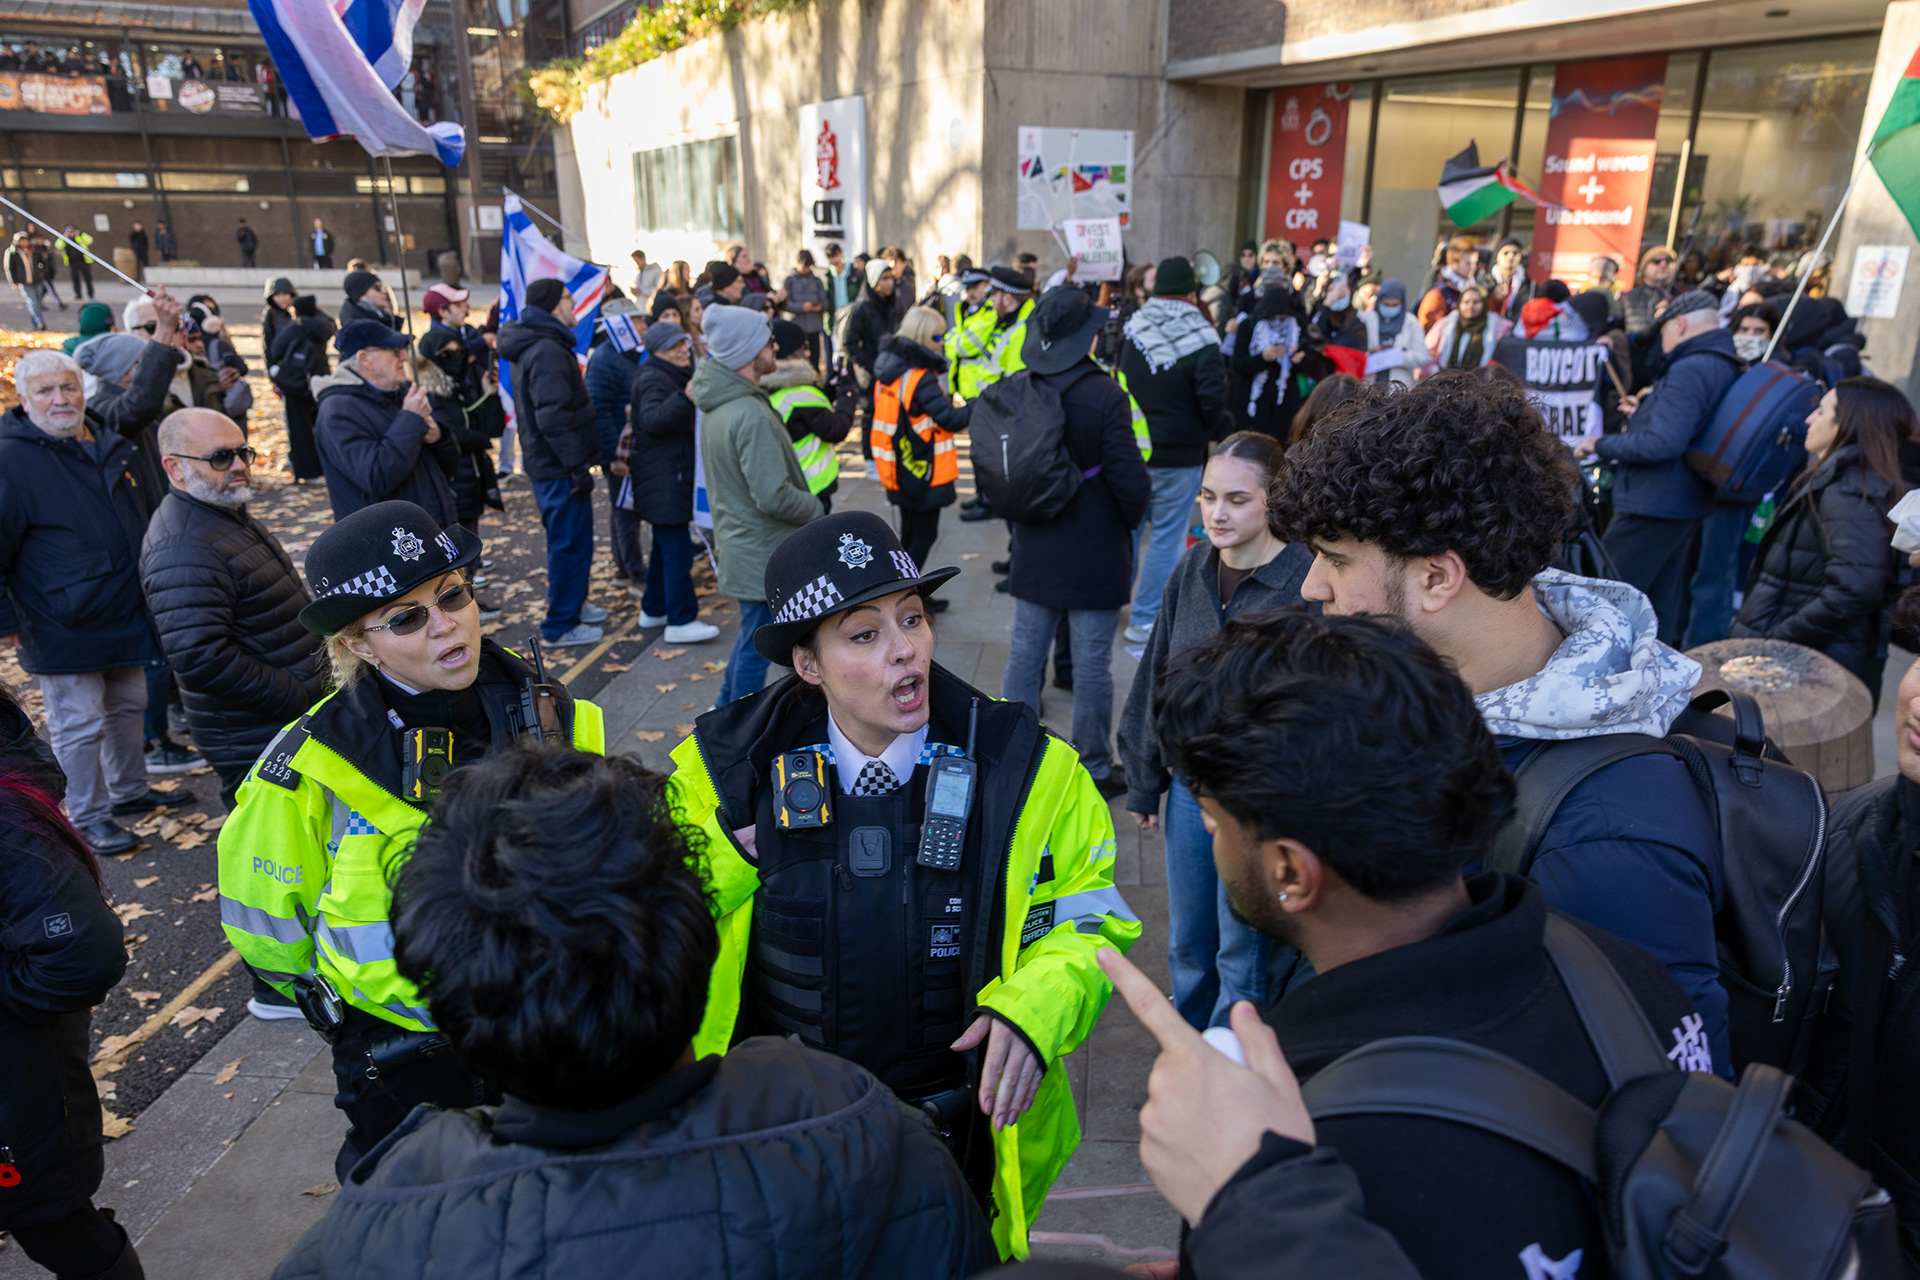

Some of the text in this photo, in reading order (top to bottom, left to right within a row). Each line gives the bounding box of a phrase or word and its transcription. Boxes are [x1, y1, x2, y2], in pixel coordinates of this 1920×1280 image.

[1289, 157, 1323, 180] CPS
[1545, 153, 1649, 173] Sound waves
[814, 199, 843, 224] CITY
[1285, 208, 1318, 230] CPR
[252, 856, 304, 885] POLICE
[1023, 918, 1044, 931] OLICE
